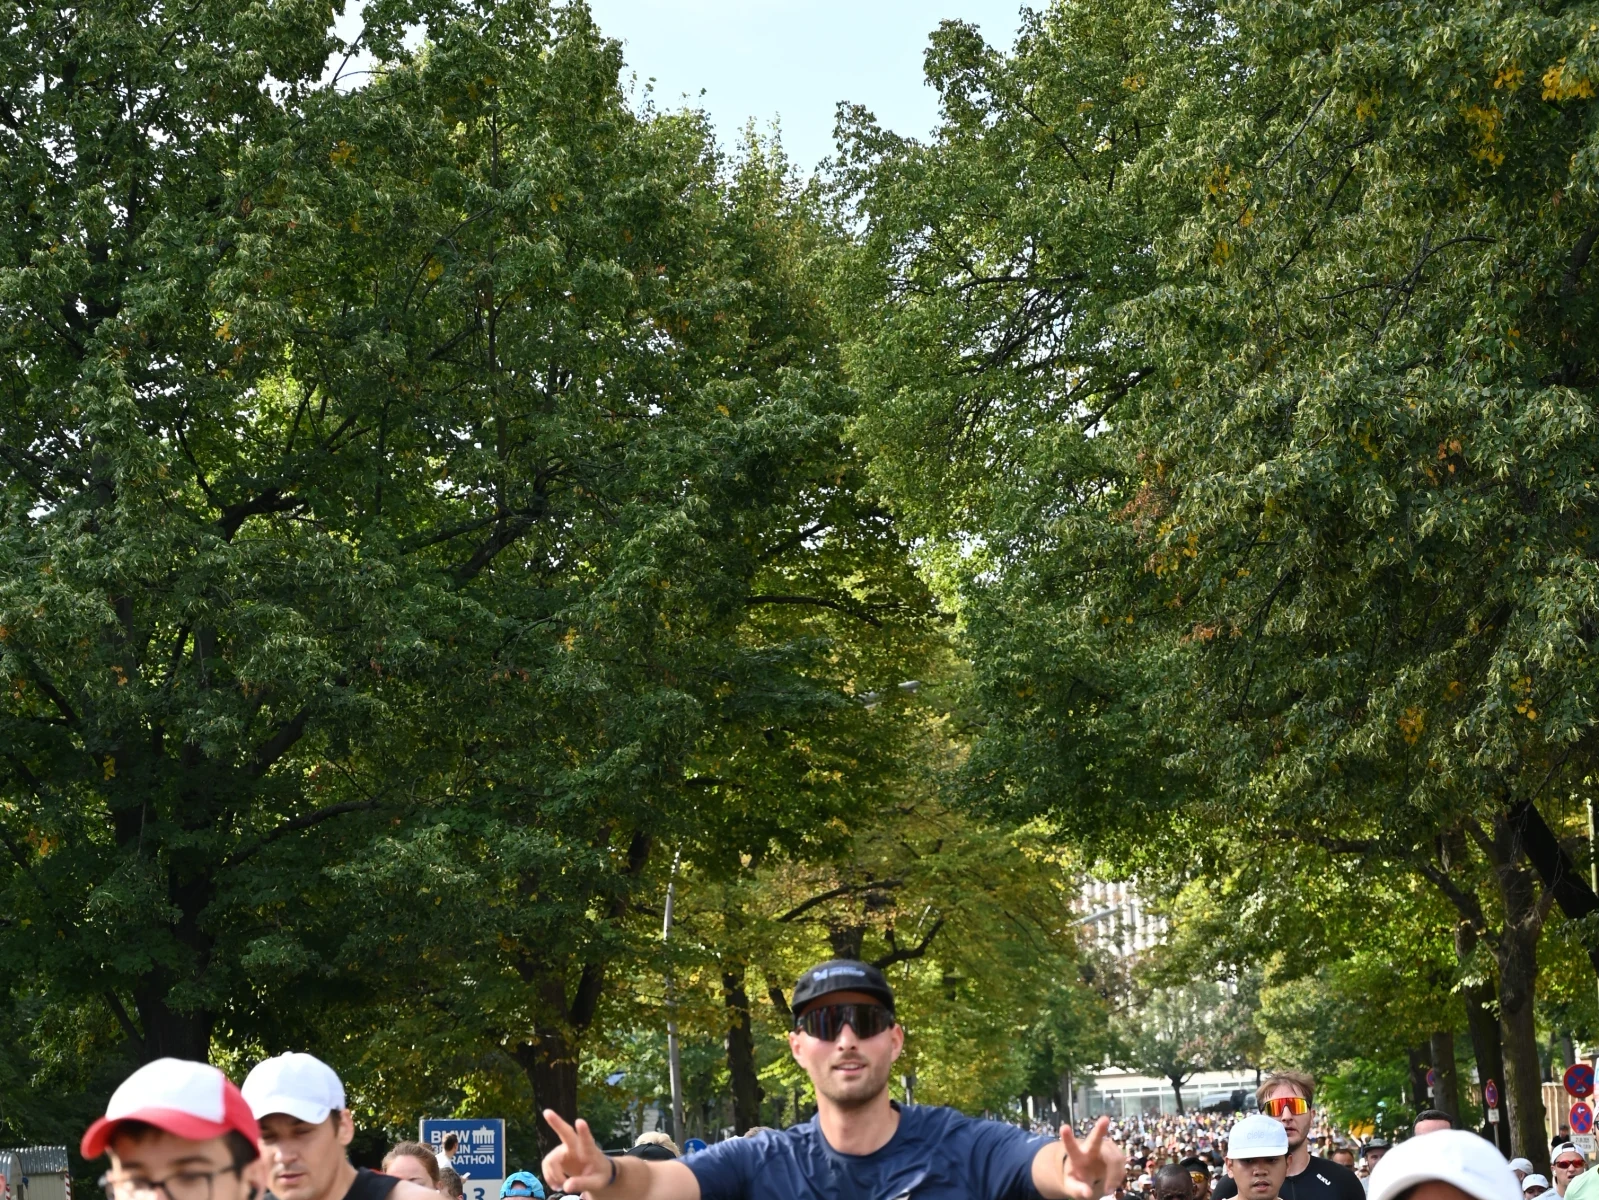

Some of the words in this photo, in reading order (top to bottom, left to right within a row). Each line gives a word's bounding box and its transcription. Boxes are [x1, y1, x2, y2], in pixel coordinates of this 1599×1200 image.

[431, 1130, 470, 1143] BW
[432, 1144, 470, 1154] BIN
[451, 1155, 494, 1165] RATHON
